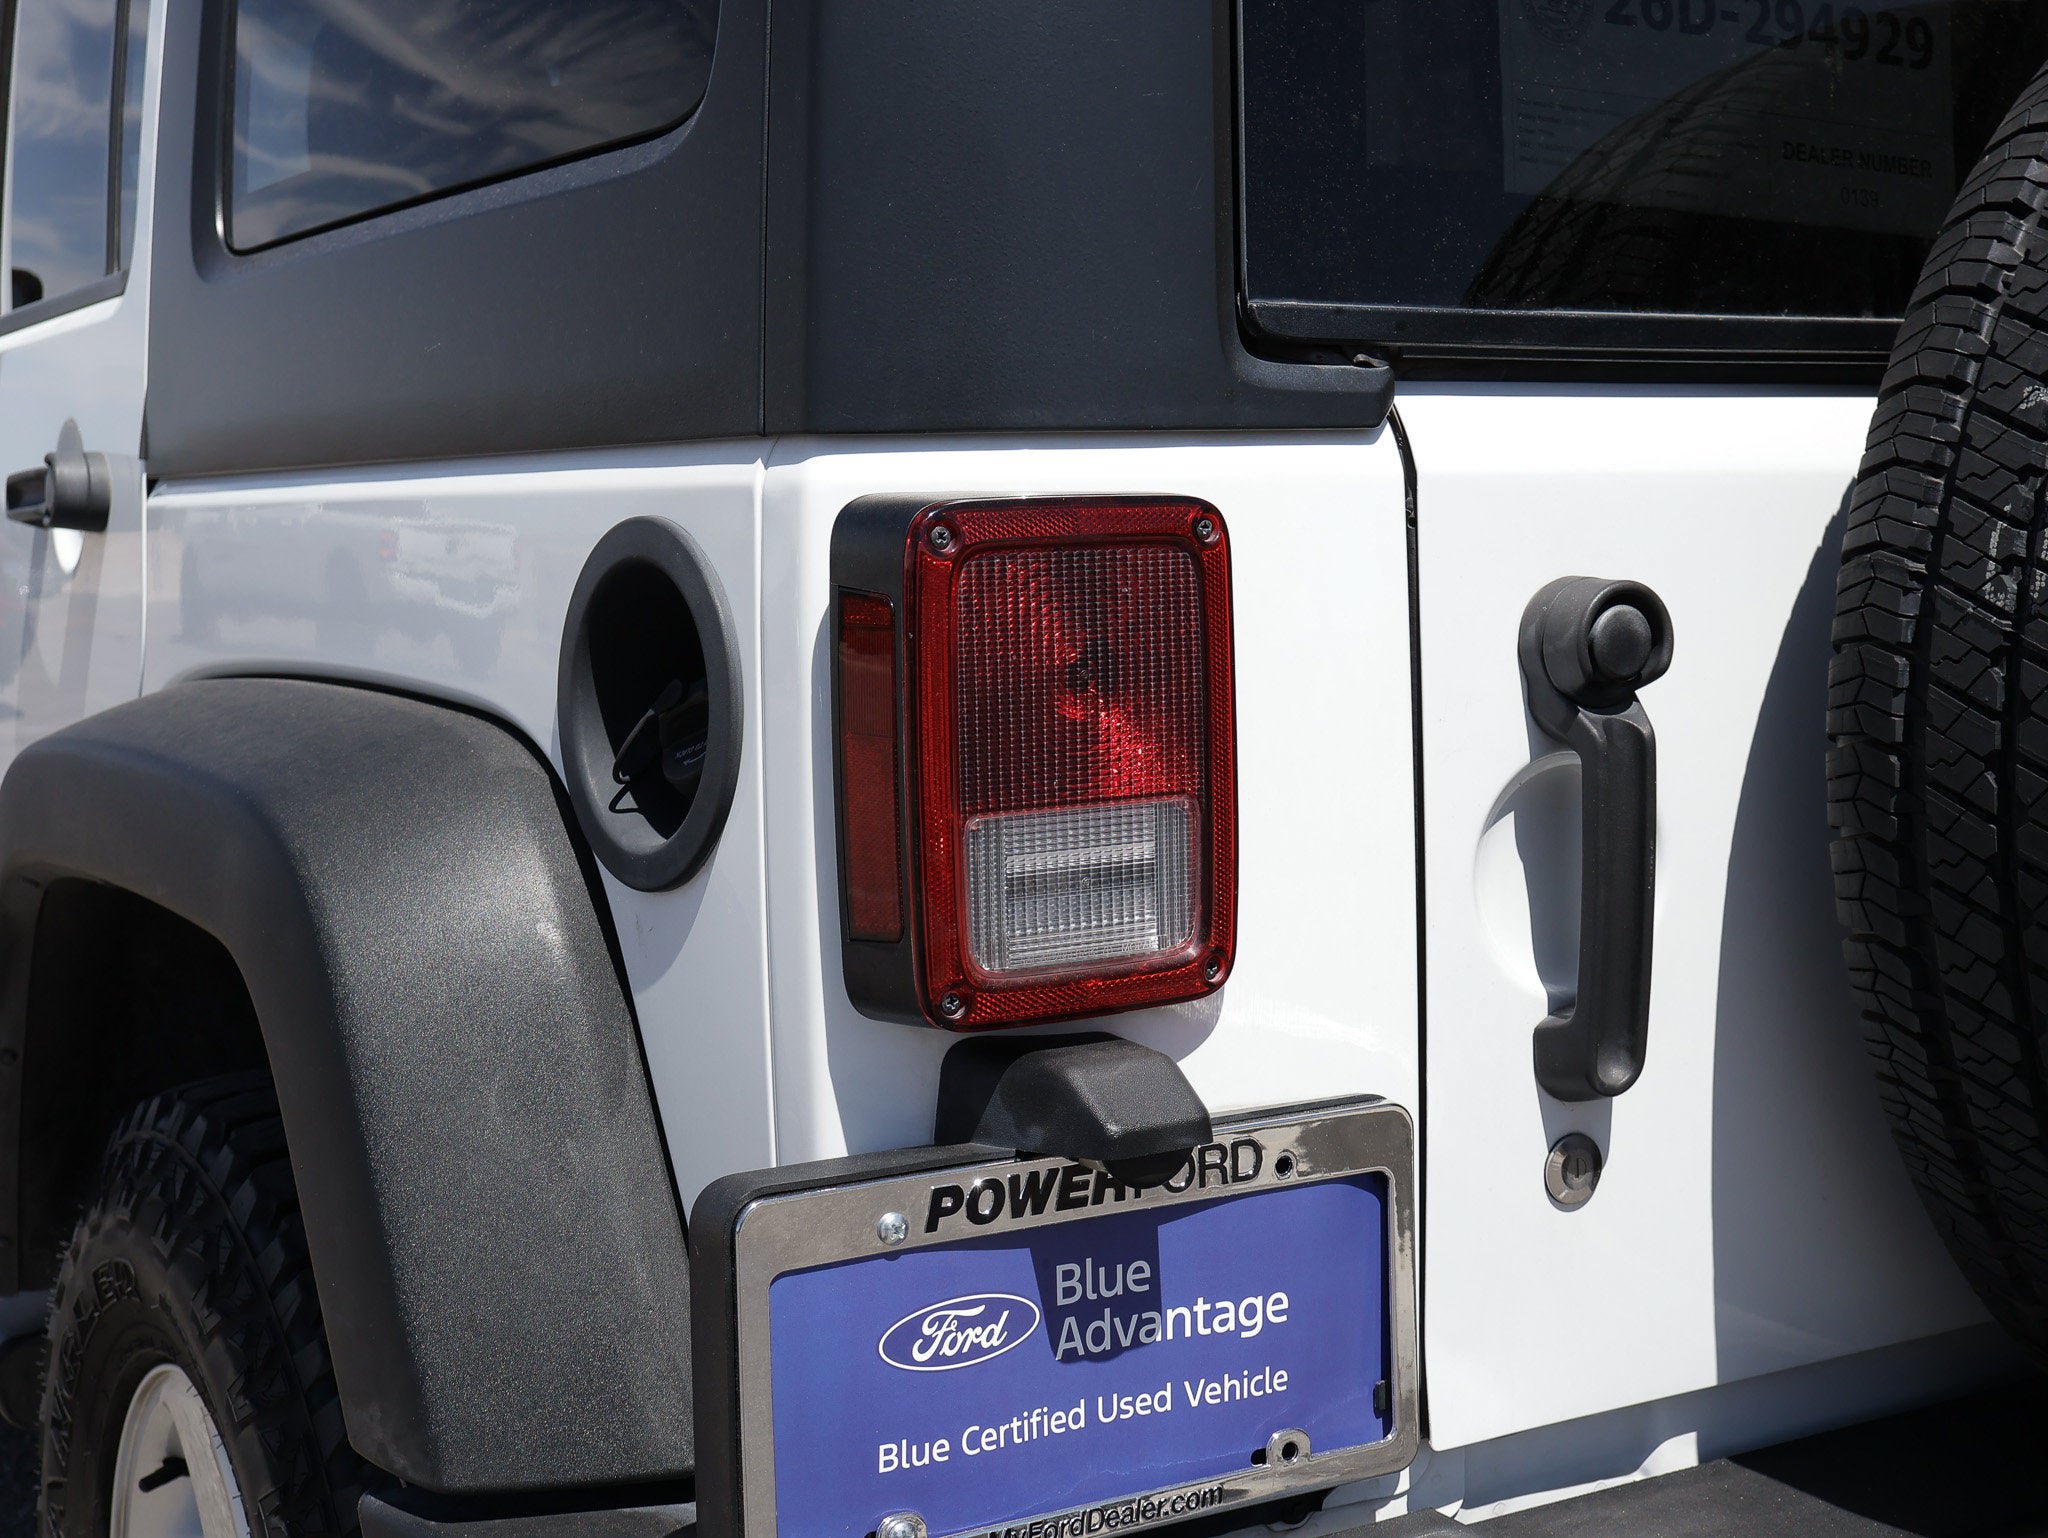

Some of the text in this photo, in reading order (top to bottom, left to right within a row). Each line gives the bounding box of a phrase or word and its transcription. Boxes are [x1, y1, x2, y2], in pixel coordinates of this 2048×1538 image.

[1782, 140, 1853, 168] DEALER
[1858, 150, 1932, 178] NUMBER
[1055, 1257, 1151, 1307] Blue
[911, 1303, 1010, 1362] Ford
[1055, 1290, 1290, 1361] Advantage
[877, 1365, 1289, 1474] Blue Certified Used Vehicle
